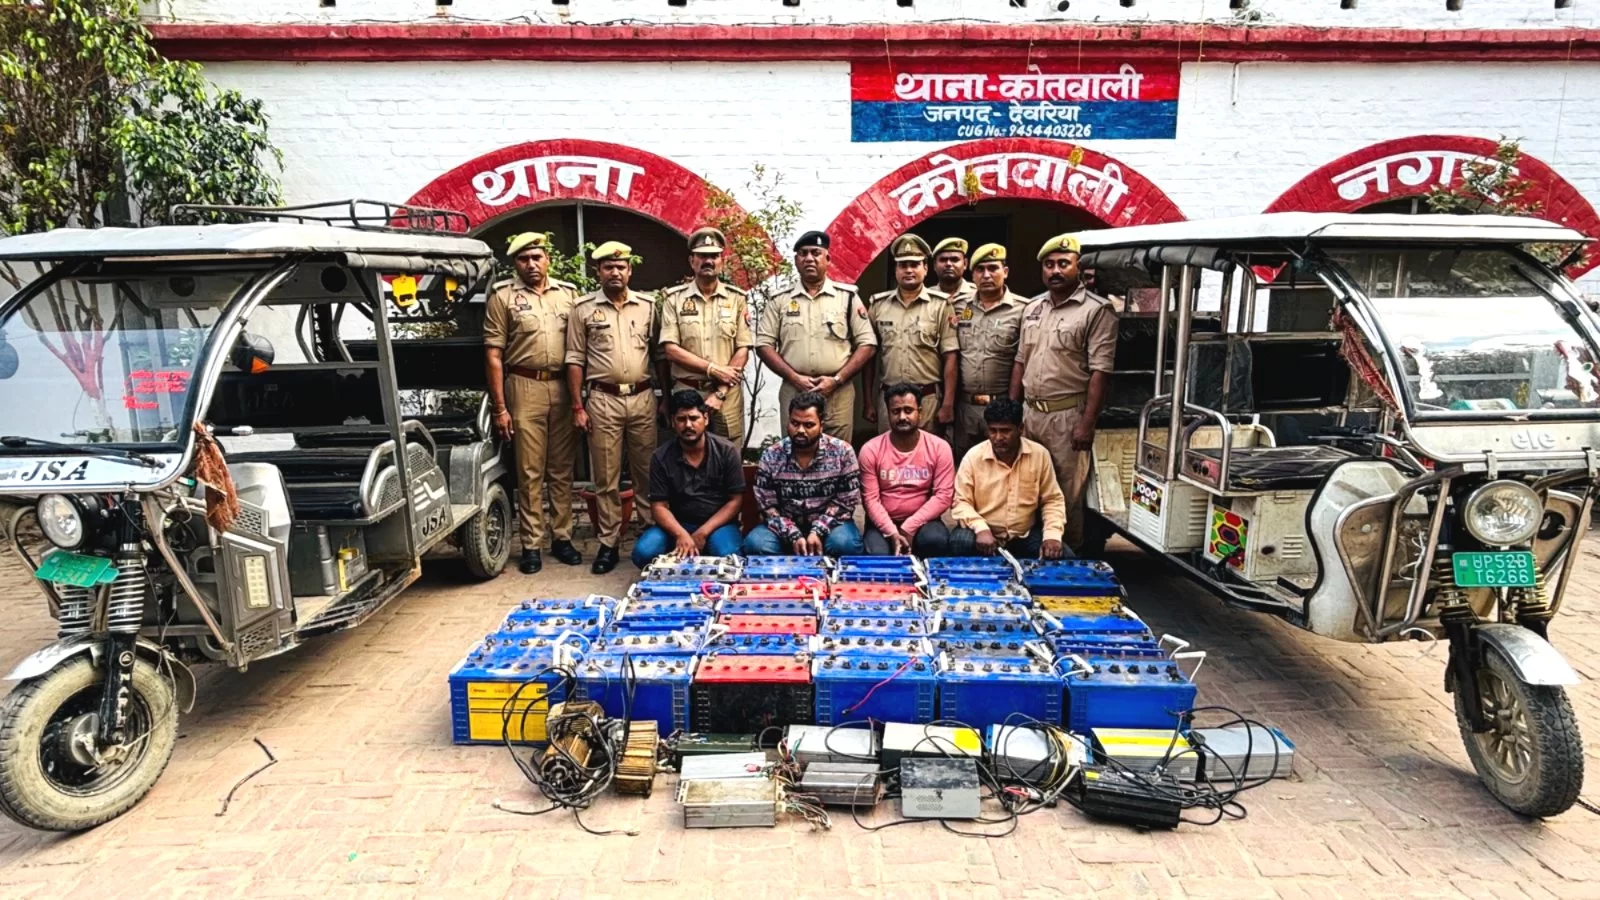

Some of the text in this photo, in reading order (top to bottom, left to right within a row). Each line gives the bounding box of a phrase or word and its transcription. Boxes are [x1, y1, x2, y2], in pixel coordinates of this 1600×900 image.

[1008, 100, 1081, 123] देवरिया
[957, 124, 984, 137] CUG
[1008, 123, 1092, 138] 9454403226
[471, 155, 646, 207] थाना
[888, 152, 1129, 218] कोतवाली
[21, 459, 90, 482] JSA
[880, 468, 930, 480] BEYOND
[421, 506, 447, 537] JSA
[1474, 569, 1530, 584] T6266
